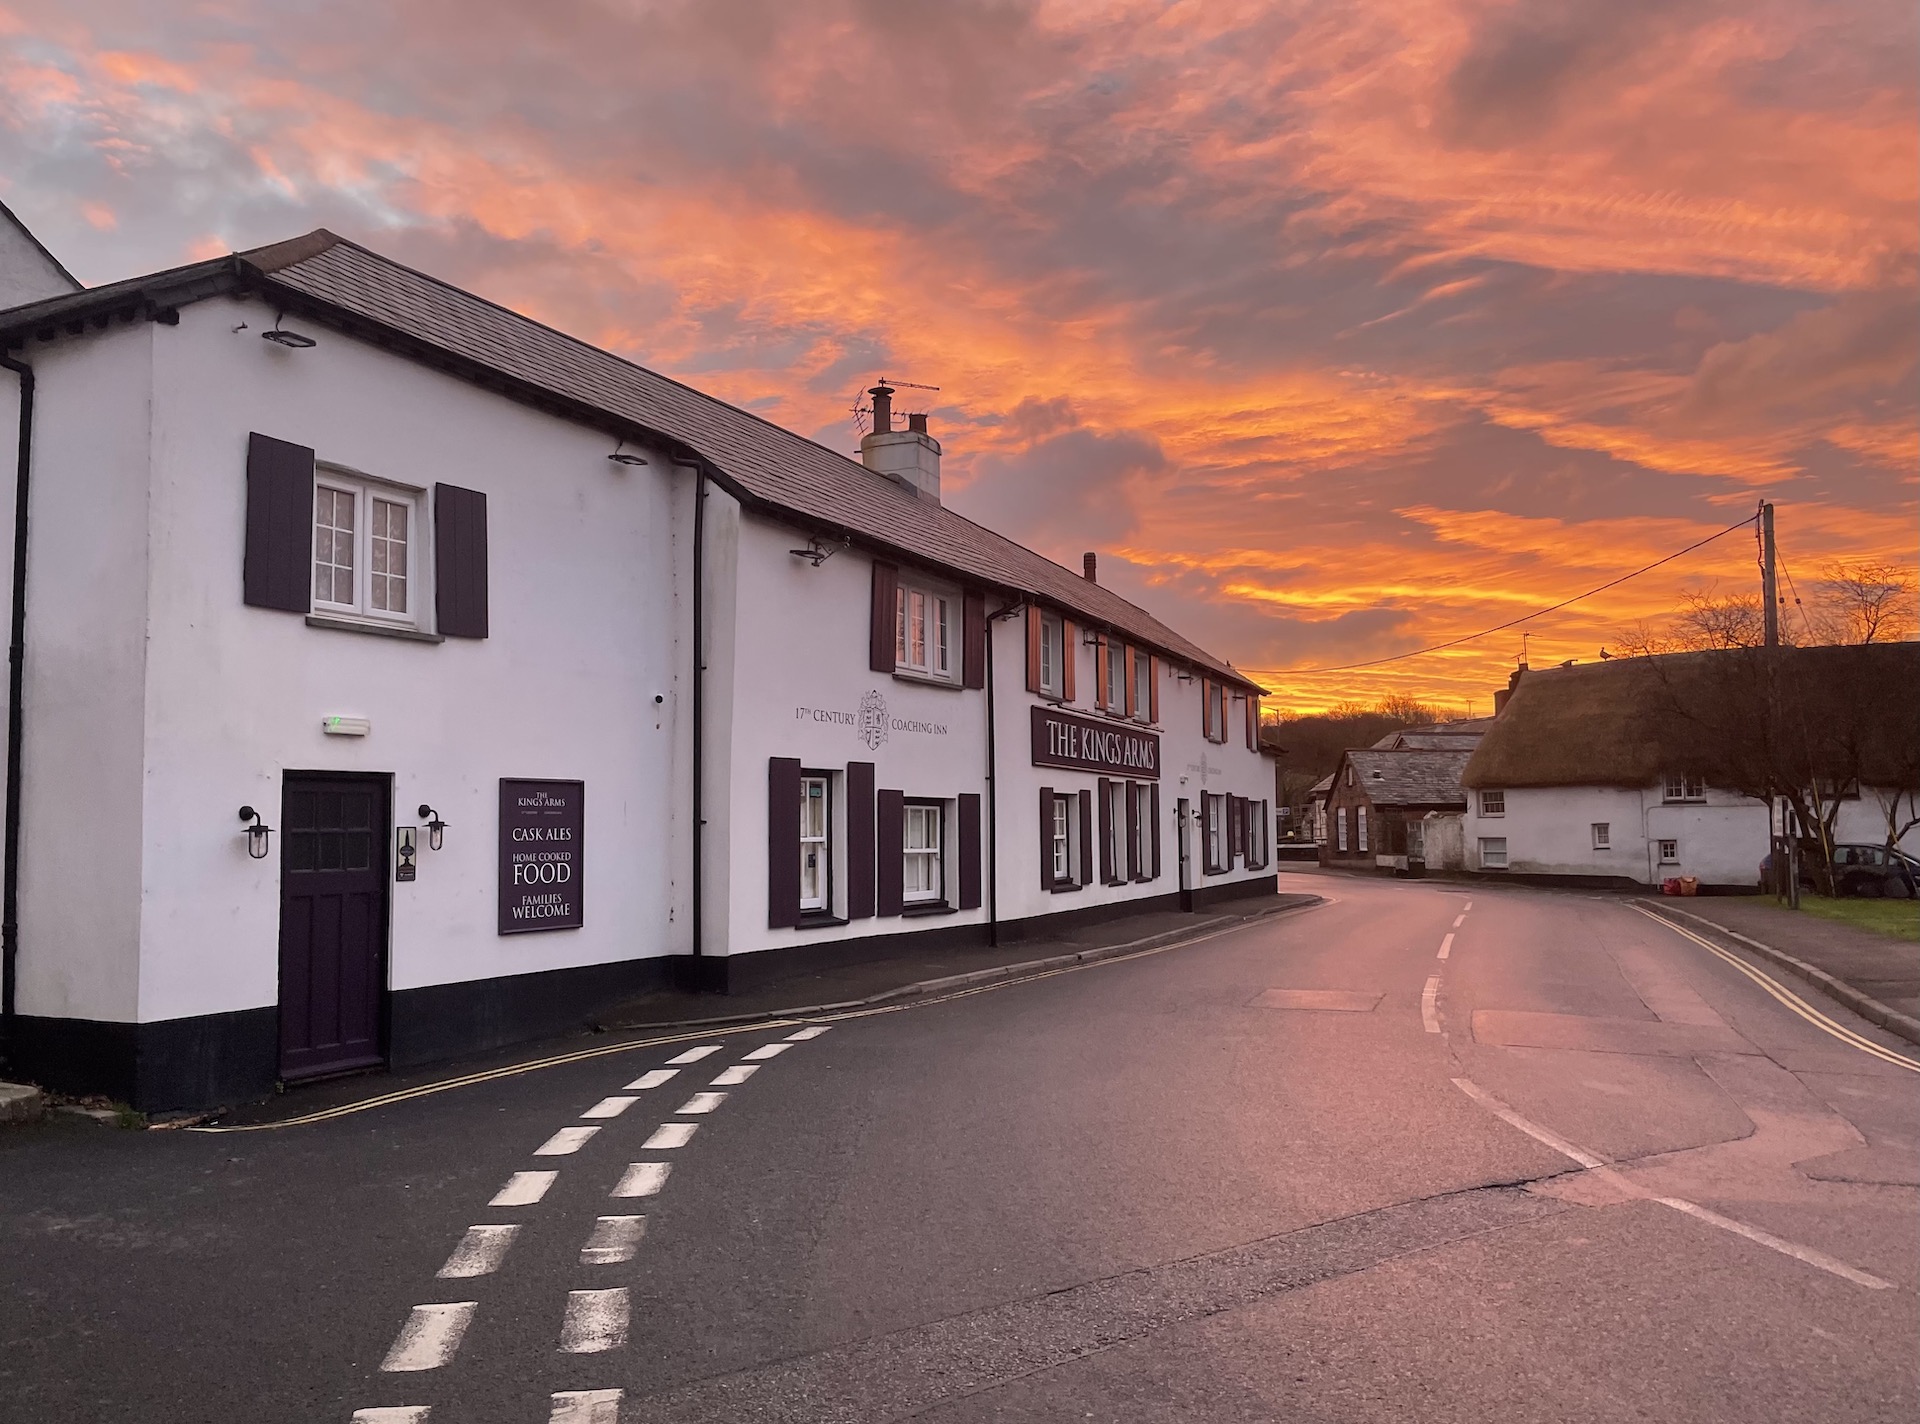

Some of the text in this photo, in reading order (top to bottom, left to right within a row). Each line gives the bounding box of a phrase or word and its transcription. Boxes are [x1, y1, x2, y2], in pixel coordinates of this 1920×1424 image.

[813, 709, 856, 725] CENTURY
[891, 718, 933, 735] COACHING
[933, 723, 948, 735] INN
[1046, 720, 1155, 770] THE KINGS ARMS
[518, 797, 566, 807] KINGS ARMS
[536, 791, 548, 799] THE
[512, 827, 572, 842] CASK ALES
[512, 851, 572, 863] HOME COOKED
[513, 862, 571, 885] FOOD
[522, 893, 563, 906] FAMILIES
[512, 903, 570, 919] WELCOME
